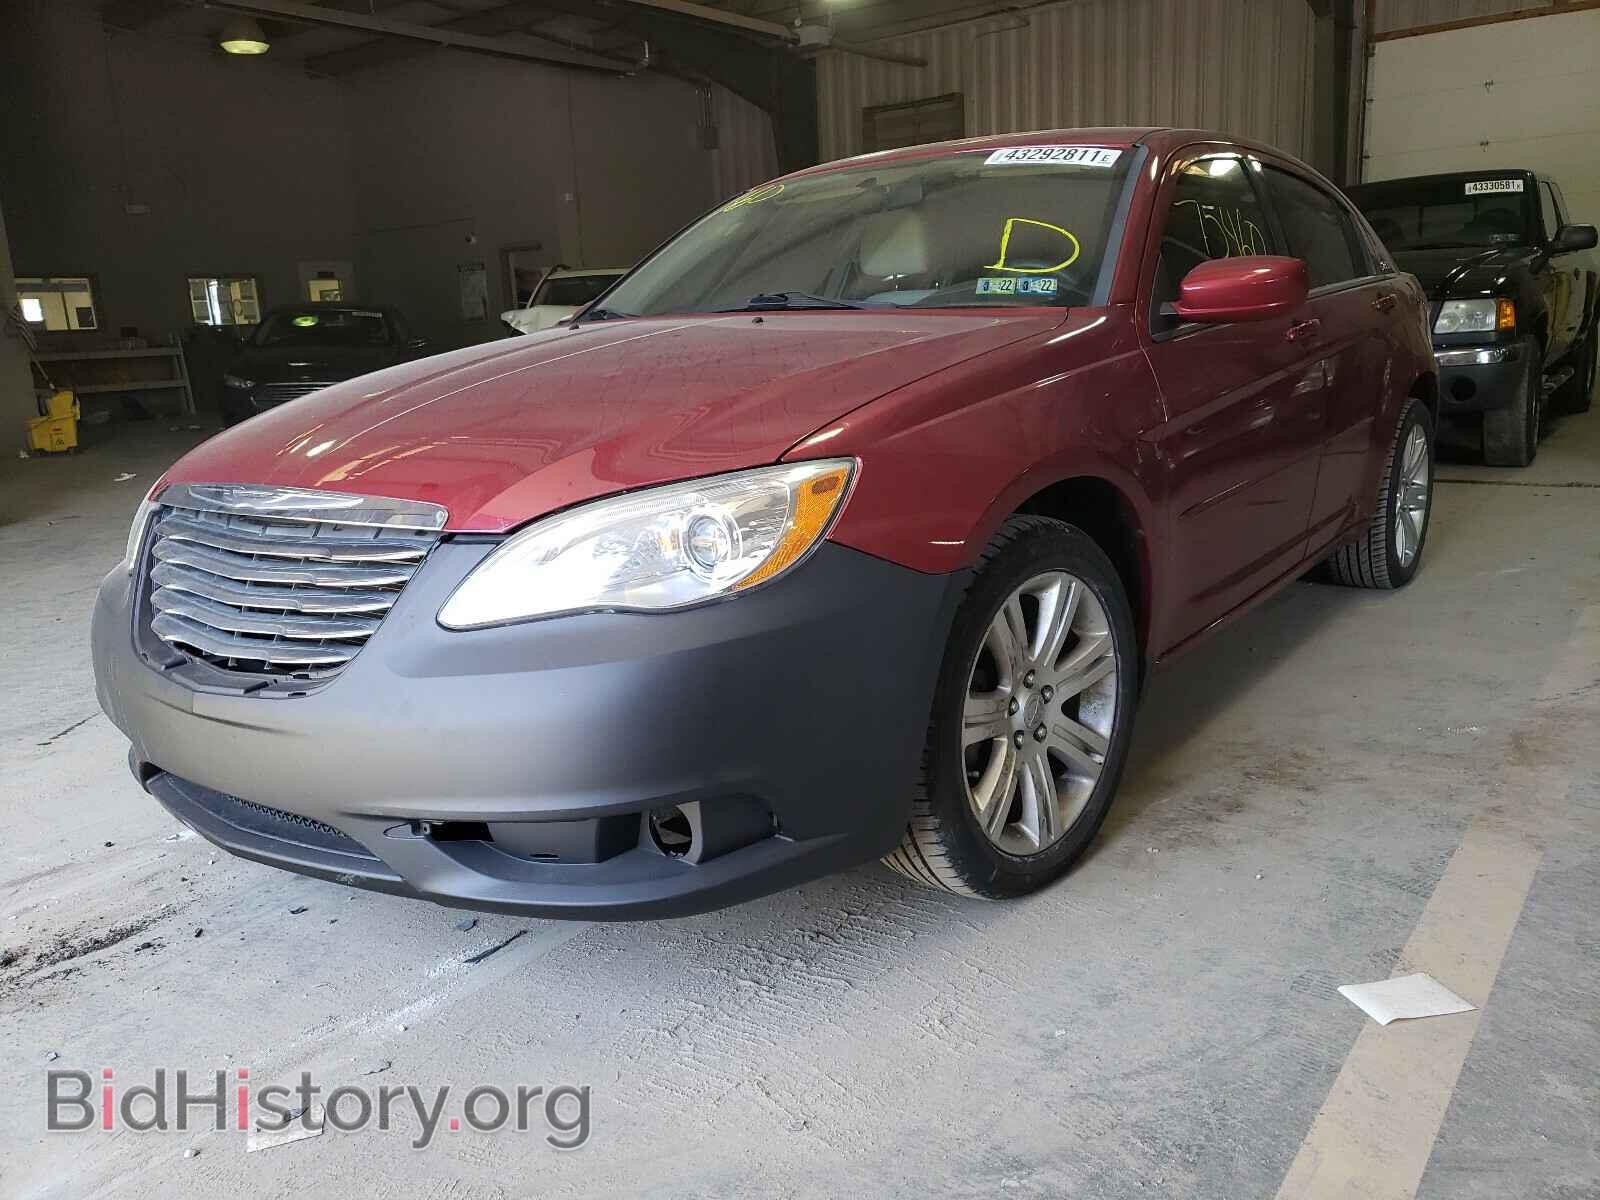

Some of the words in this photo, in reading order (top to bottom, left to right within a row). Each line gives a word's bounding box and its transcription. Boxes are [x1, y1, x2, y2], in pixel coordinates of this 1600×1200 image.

[983, 217, 1080, 274] D
[1000, 279, 1013, 291] 22
[1040, 279, 1052, 291] 22
